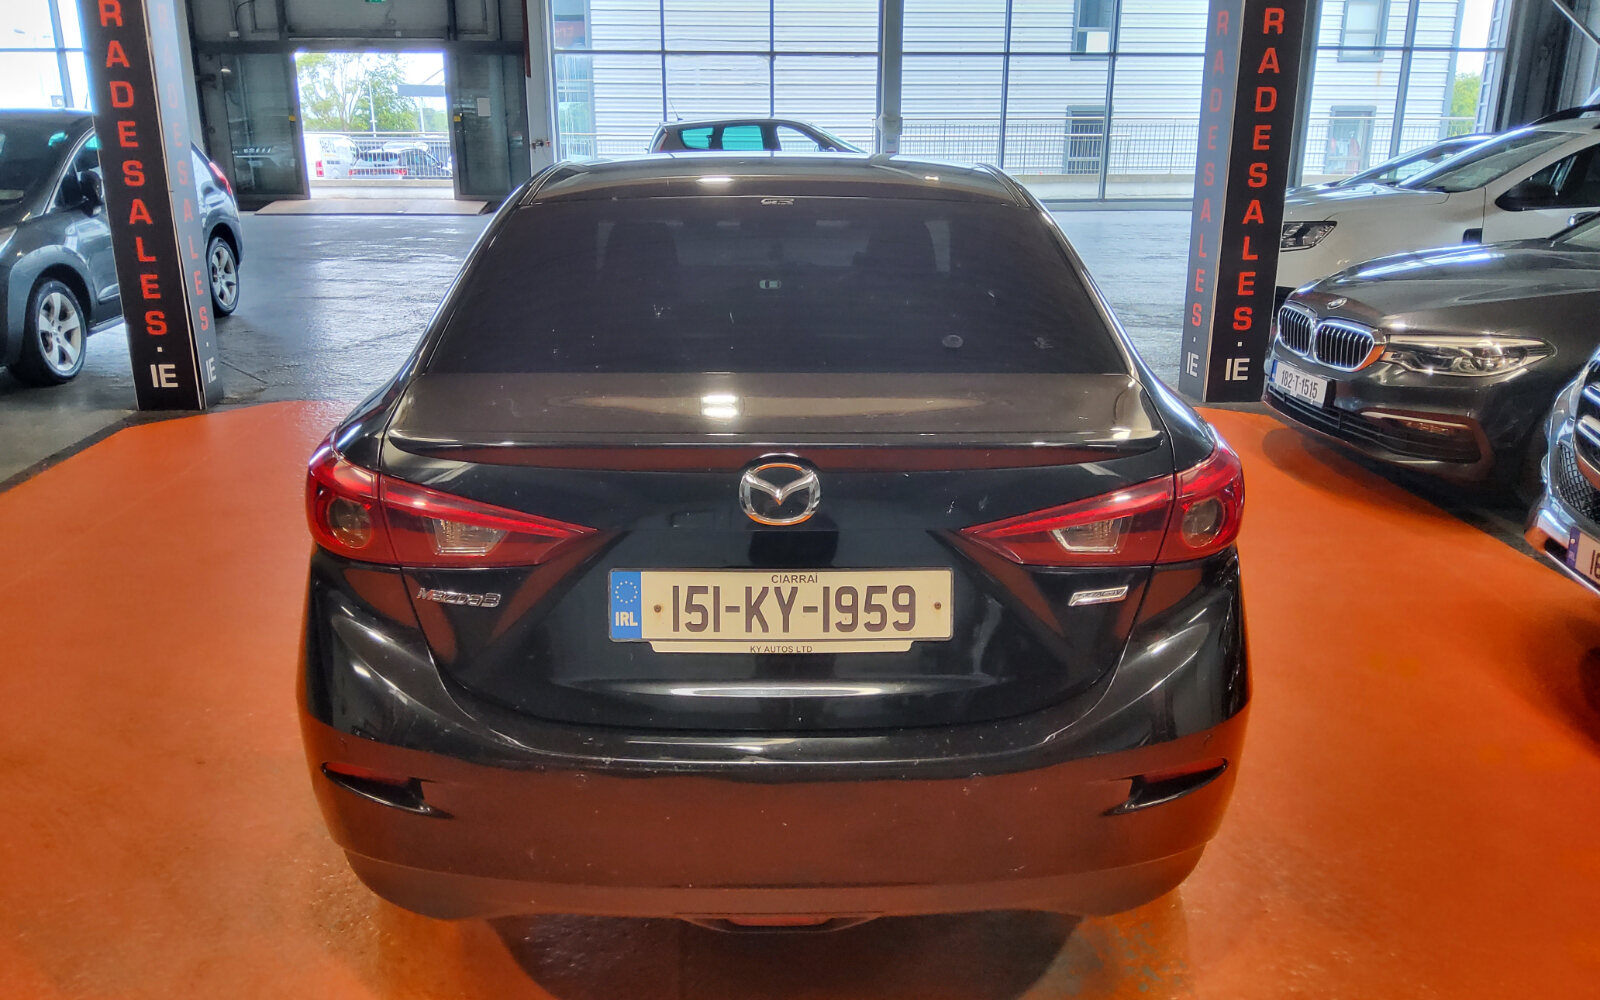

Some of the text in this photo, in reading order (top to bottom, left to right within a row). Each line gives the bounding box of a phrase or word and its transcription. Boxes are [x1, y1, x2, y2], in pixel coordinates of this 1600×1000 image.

[1281, 370, 1319, 399] 182-T-1515
[615, 611, 638, 627] IRL
[672, 585, 916, 633] 151-KY-1959
[750, 645, 813, 653] KY AUTOS LTD
